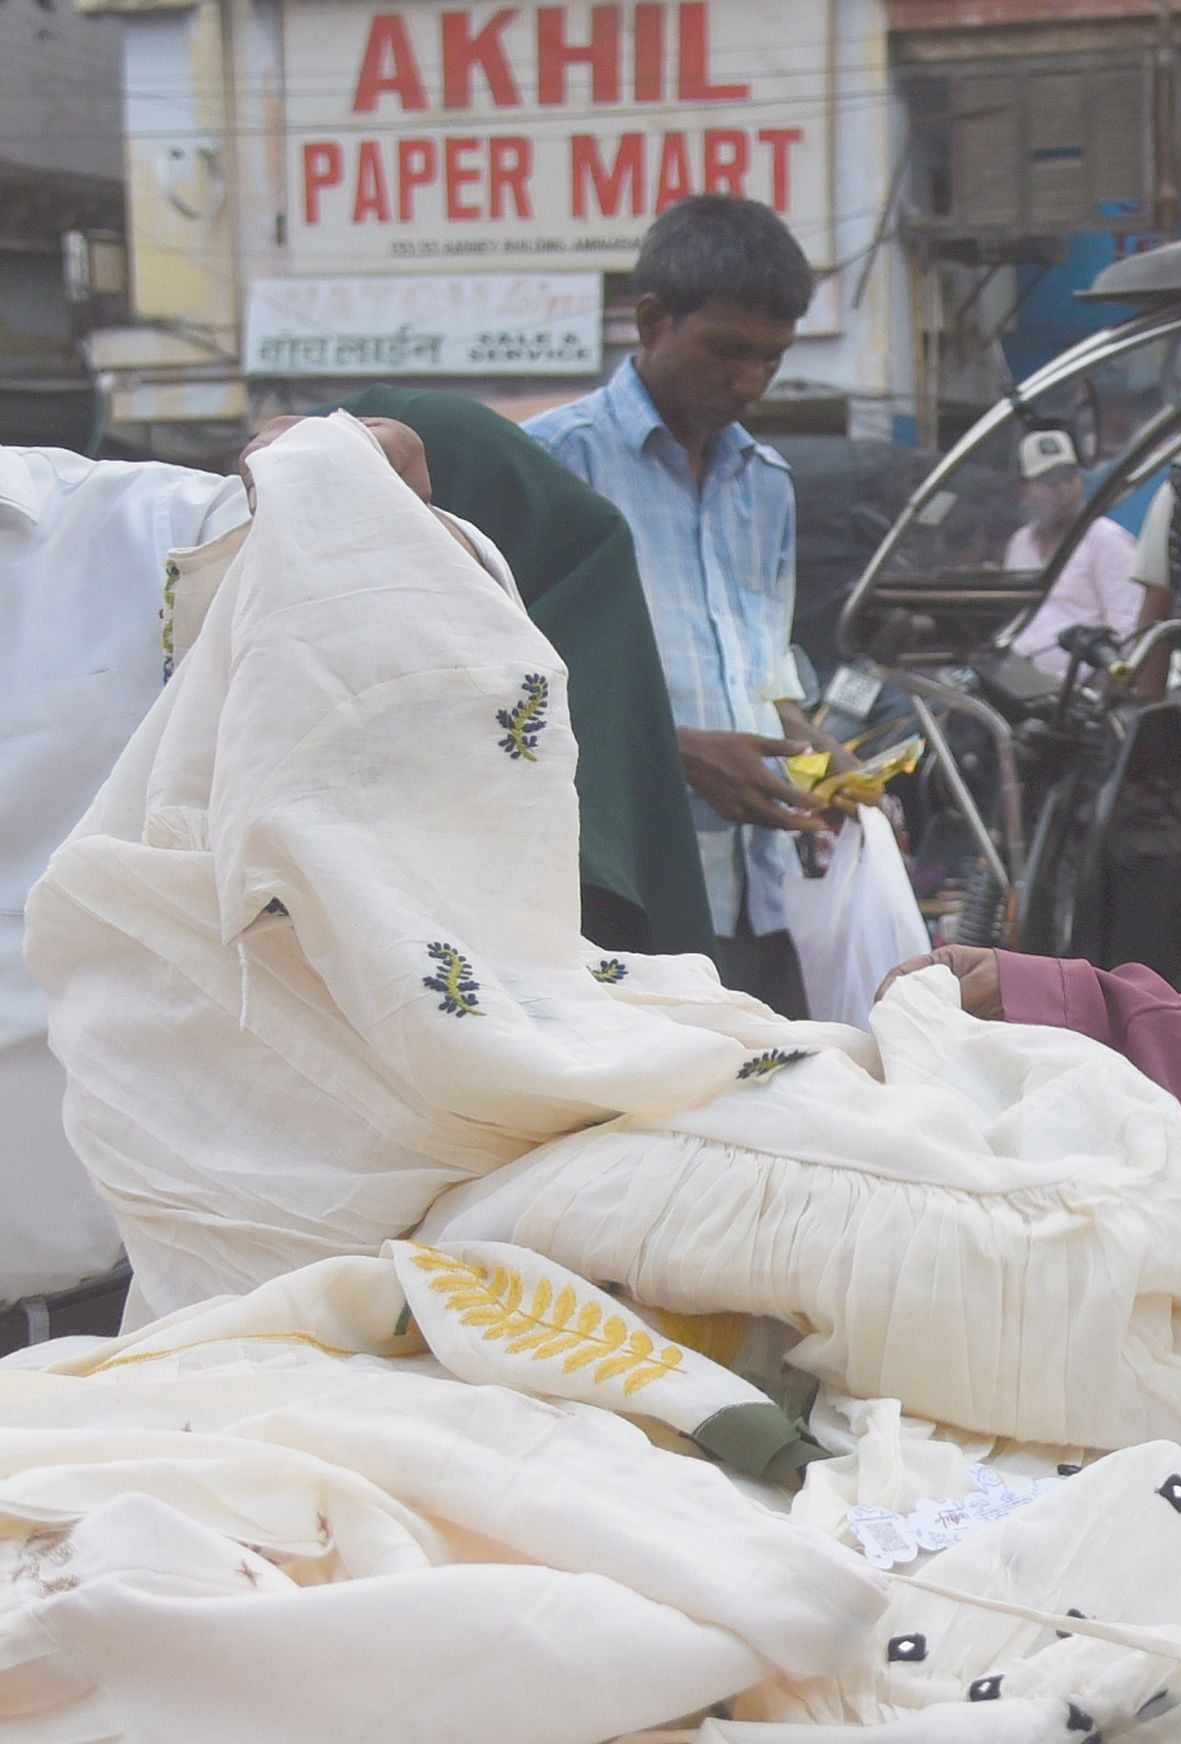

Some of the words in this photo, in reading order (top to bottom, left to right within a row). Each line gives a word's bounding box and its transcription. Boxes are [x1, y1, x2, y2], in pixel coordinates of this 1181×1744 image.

[352, 2, 751, 113] AKHIL
[303, 136, 534, 225] PAPER
[570, 127, 805, 220] MART
[468, 347, 589, 361] SERVICE
